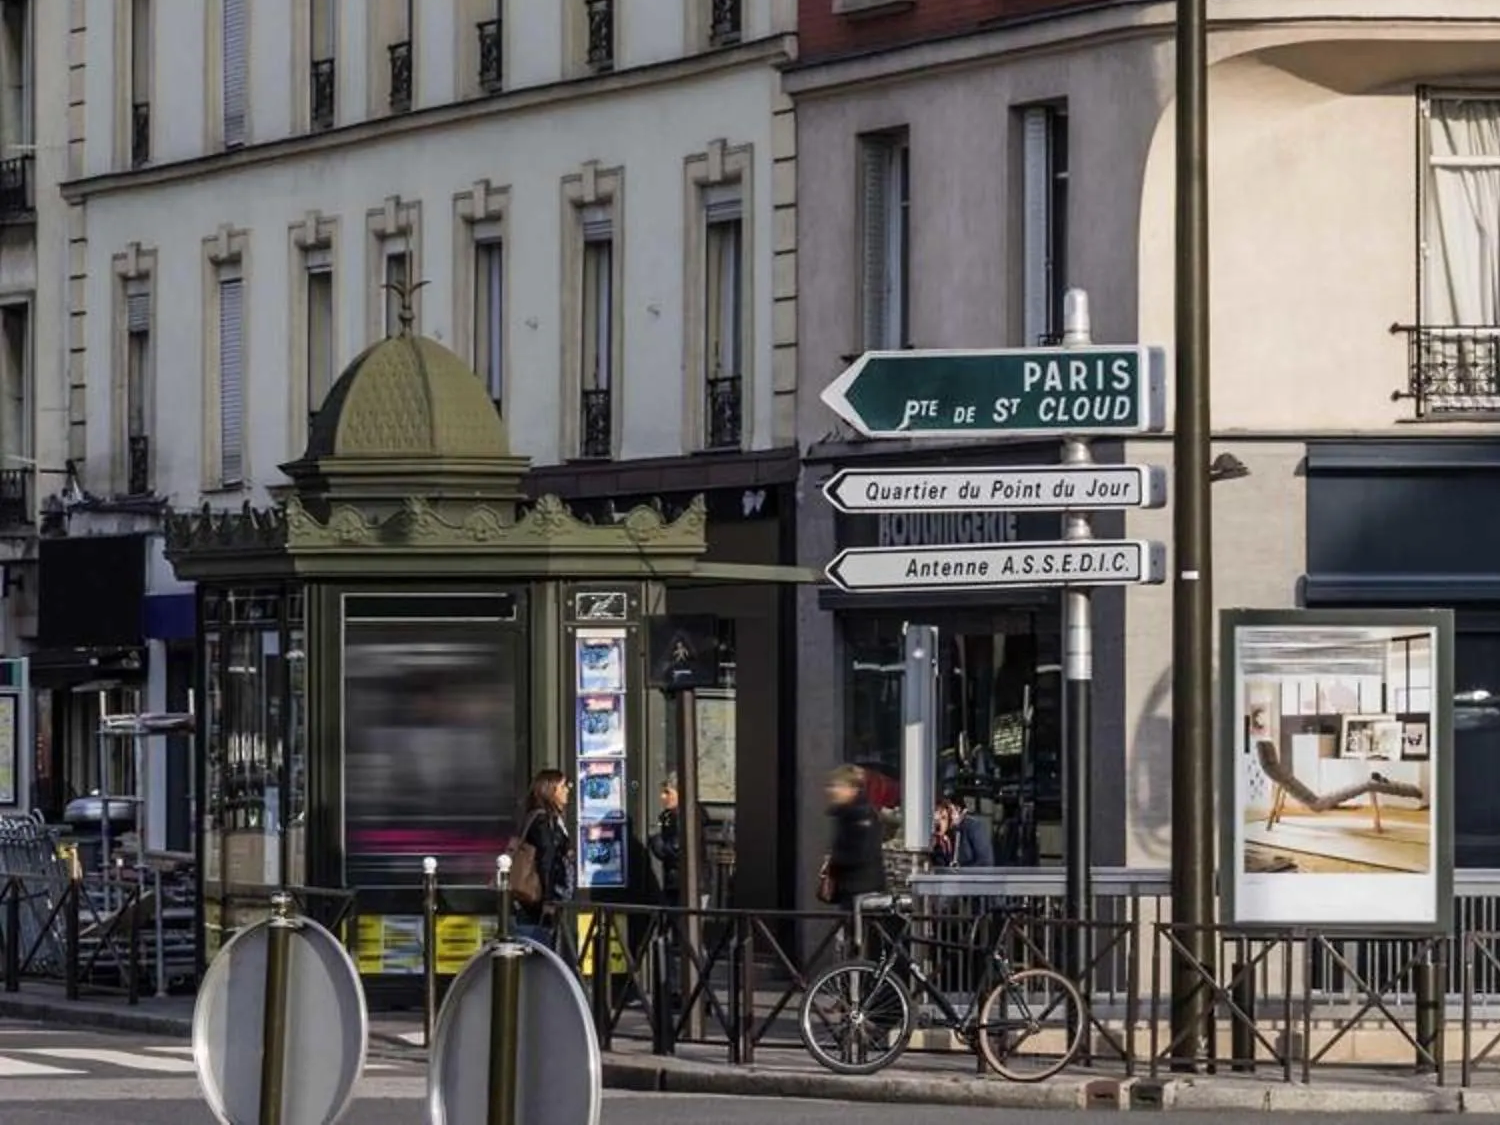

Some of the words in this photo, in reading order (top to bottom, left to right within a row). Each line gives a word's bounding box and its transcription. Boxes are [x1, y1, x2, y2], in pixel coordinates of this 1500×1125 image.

[1024, 360, 1131, 391] PARIS
[898, 399, 939, 431] PTE
[953, 406, 976, 424] DE
[993, 398, 1020, 423] ST
[1038, 395, 1131, 422] CLOUD
[865, 481, 948, 502] Quartier
[958, 479, 981, 499] du
[990, 478, 1042, 499] Point
[1053, 476, 1076, 498] du
[1085, 478, 1131, 498] Jour
[906, 557, 989, 579] Antenne
[1001, 552, 1131, 575] A.S.S.E.D.I.C.
